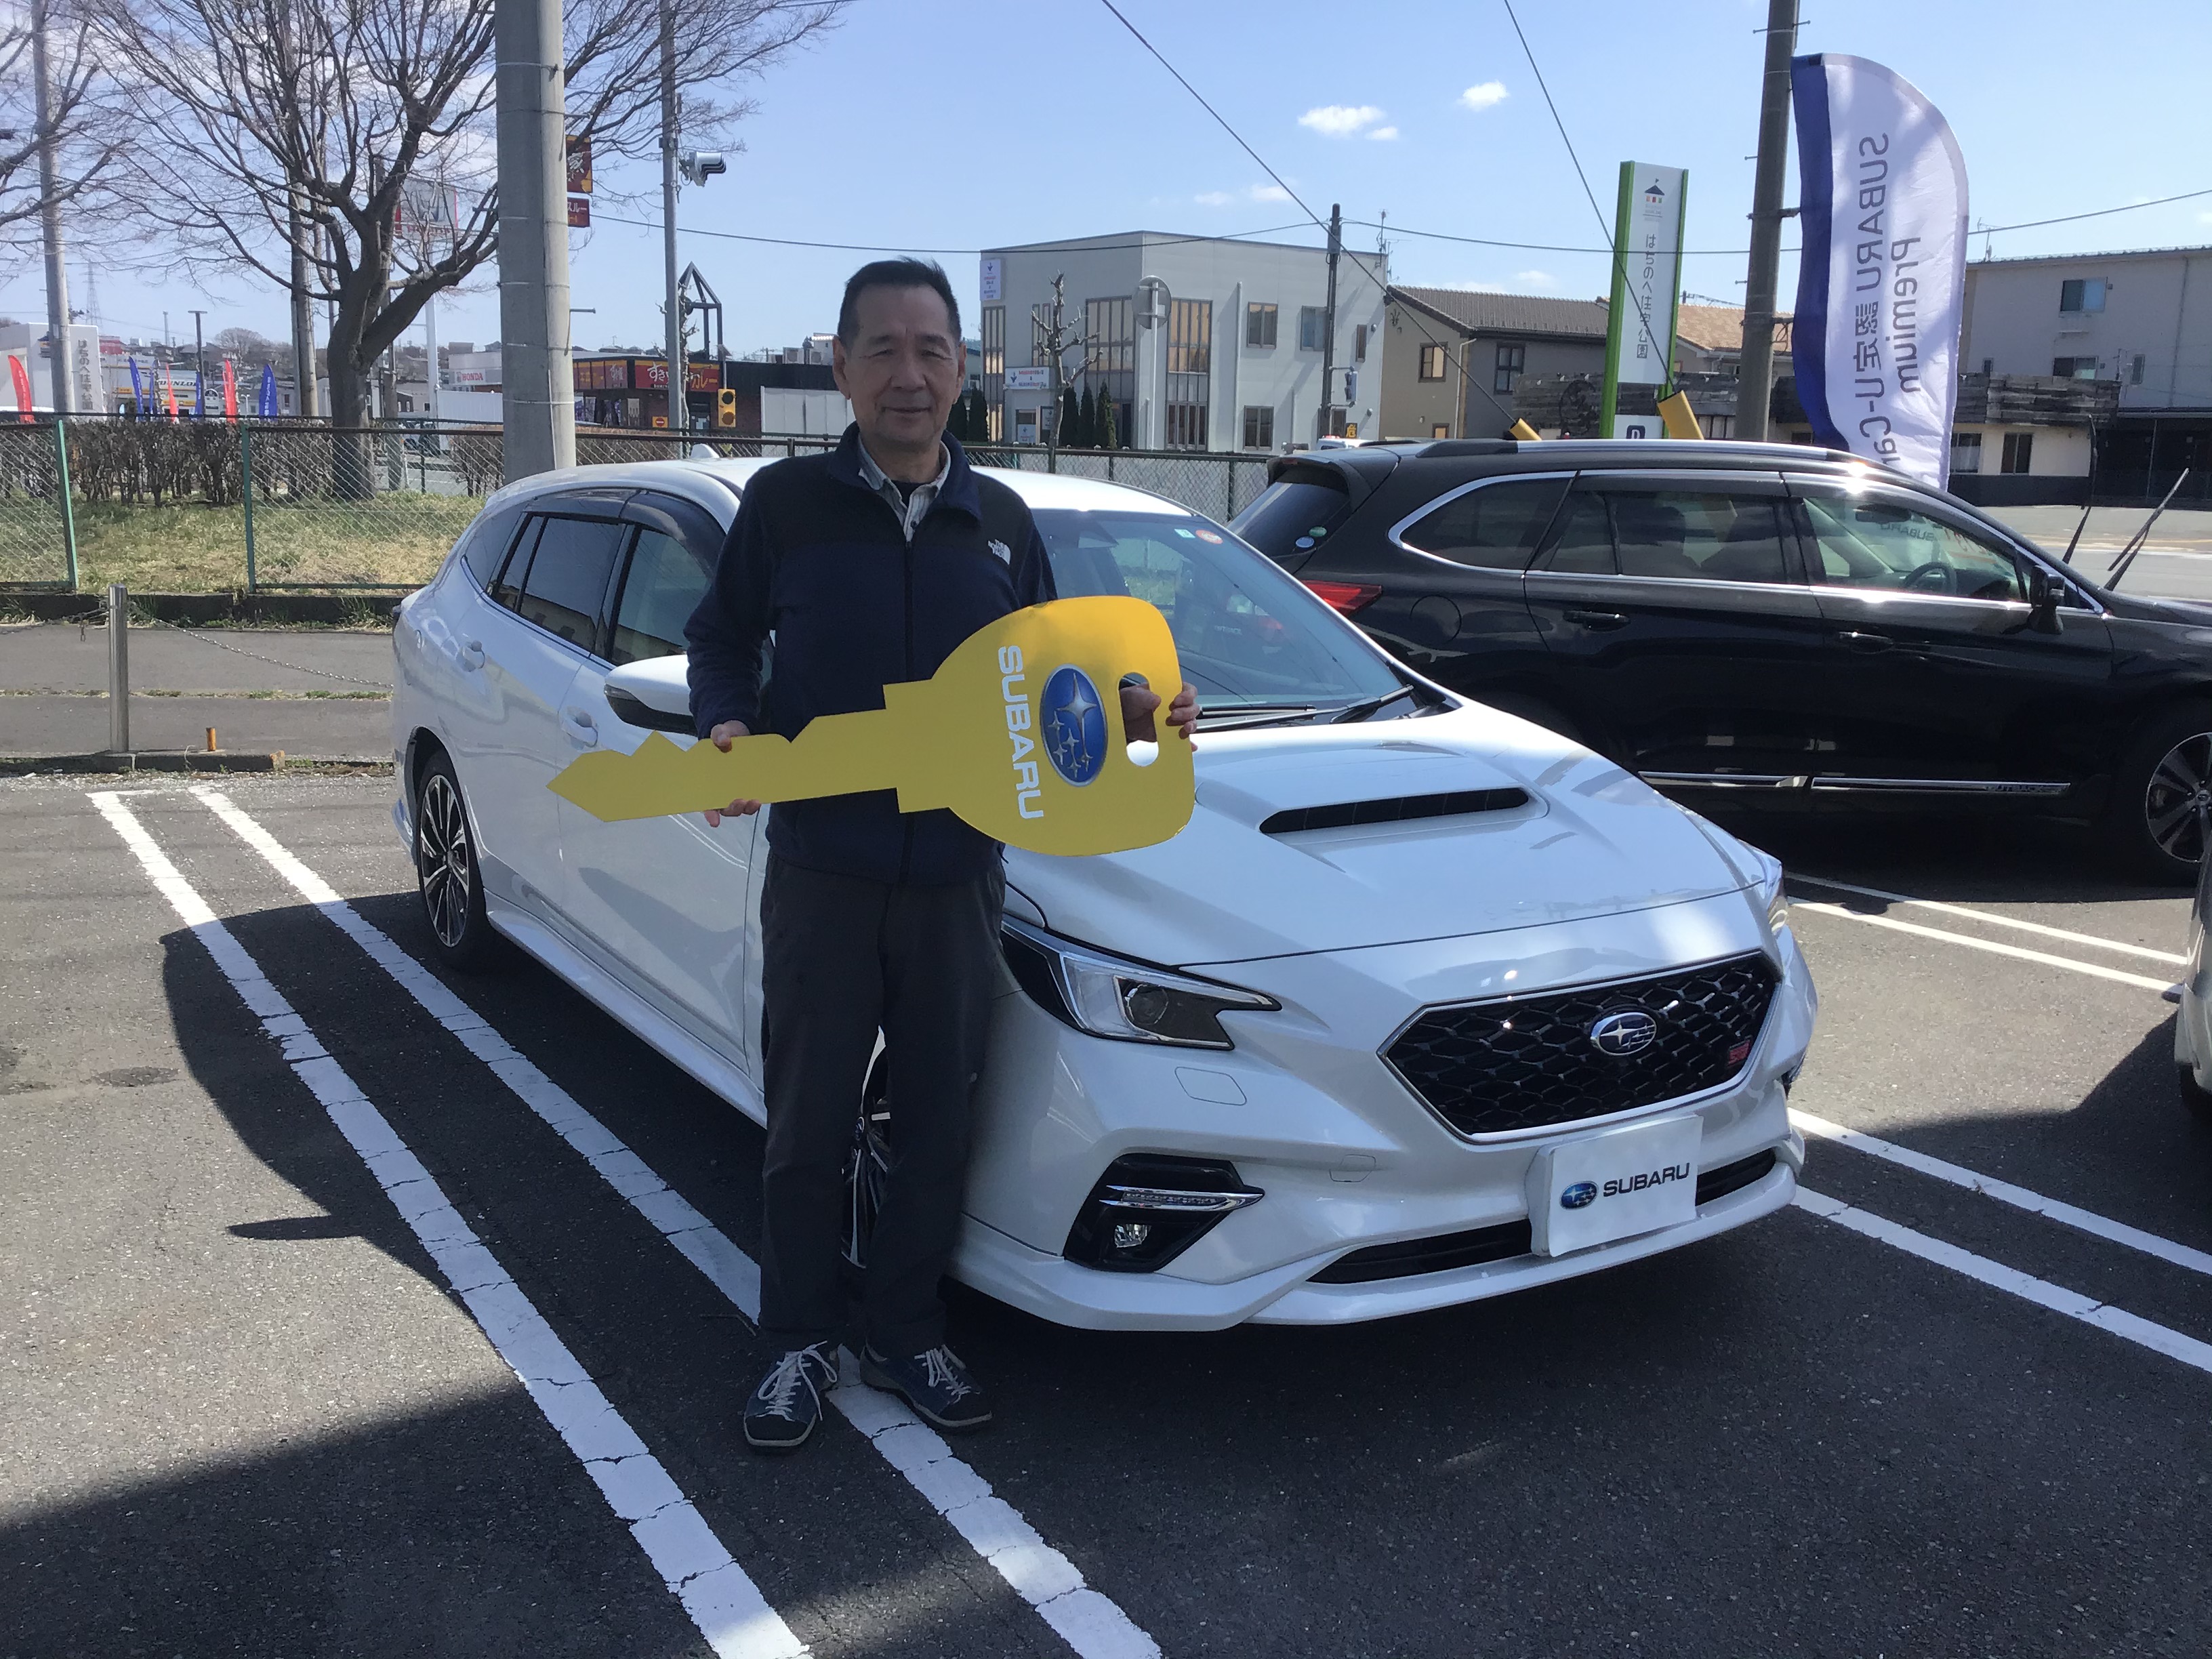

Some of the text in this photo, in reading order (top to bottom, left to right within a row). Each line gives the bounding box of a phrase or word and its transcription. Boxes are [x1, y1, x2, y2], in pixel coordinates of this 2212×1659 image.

[1637, 234, 1657, 359] はちのへ住宅公園
[462, 373, 484, 381] HONDA
[647, 361, 669, 385] すき
[998, 645, 1044, 819] SUBARU
[1603, 1162, 1690, 1197] SUBARU
